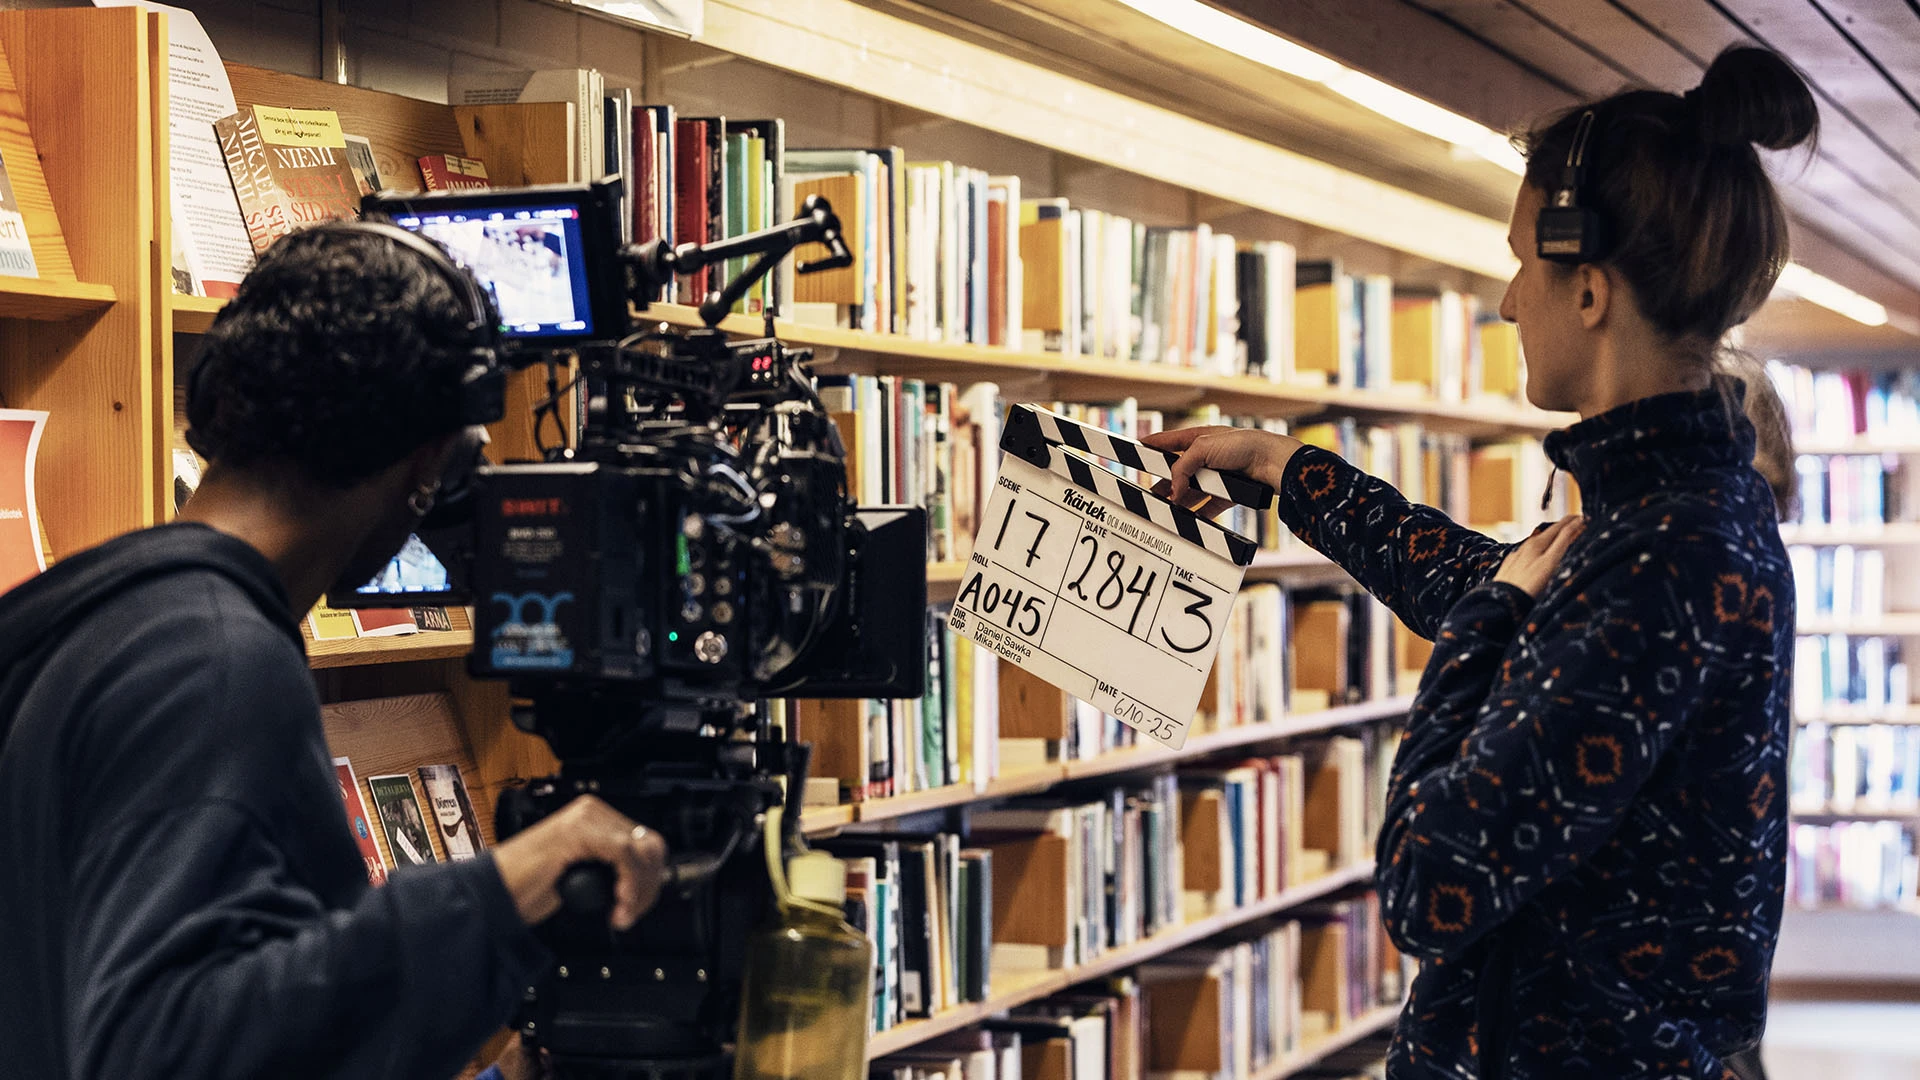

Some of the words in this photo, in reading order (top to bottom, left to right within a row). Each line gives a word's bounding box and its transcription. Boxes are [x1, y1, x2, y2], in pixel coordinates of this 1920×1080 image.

[220, 132, 256, 201] NIEMI
[235, 115, 276, 200] MIKAEL
[273, 147, 337, 169] NIEMI
[283, 174, 335, 199] STEN
[335, 173, 348, 195] I
[1558, 189, 1570, 207] 2
[291, 197, 357, 222] SIDEN
[998, 475, 1022, 494] SCENE
[994, 498, 1051, 568] 17
[1062, 488, 1108, 522] Kärlek
[1106, 514, 1120, 530] OCH
[1119, 521, 1139, 540] ANDRA
[1139, 531, 1173, 557] DIAGNOSER
[1084, 520, 1108, 538] SLATE
[972, 551, 990, 568] ROLL
[1067, 535, 1157, 635] 284
[1174, 565, 1195, 583] TAKE
[958, 572, 1046, 637] A045
[1161, 580, 1213, 654] 3
[950, 617, 966, 633] DOP.
[973, 631, 993, 648] Mika
[994, 642, 1022, 664] Aberra
[953, 607, 967, 622] DIR.
[976, 621, 1004, 641] Daniel
[1003, 636, 1032, 658] Sawka
[1098, 681, 1119, 698] DATE
[435, 796, 458, 810] Dörren
